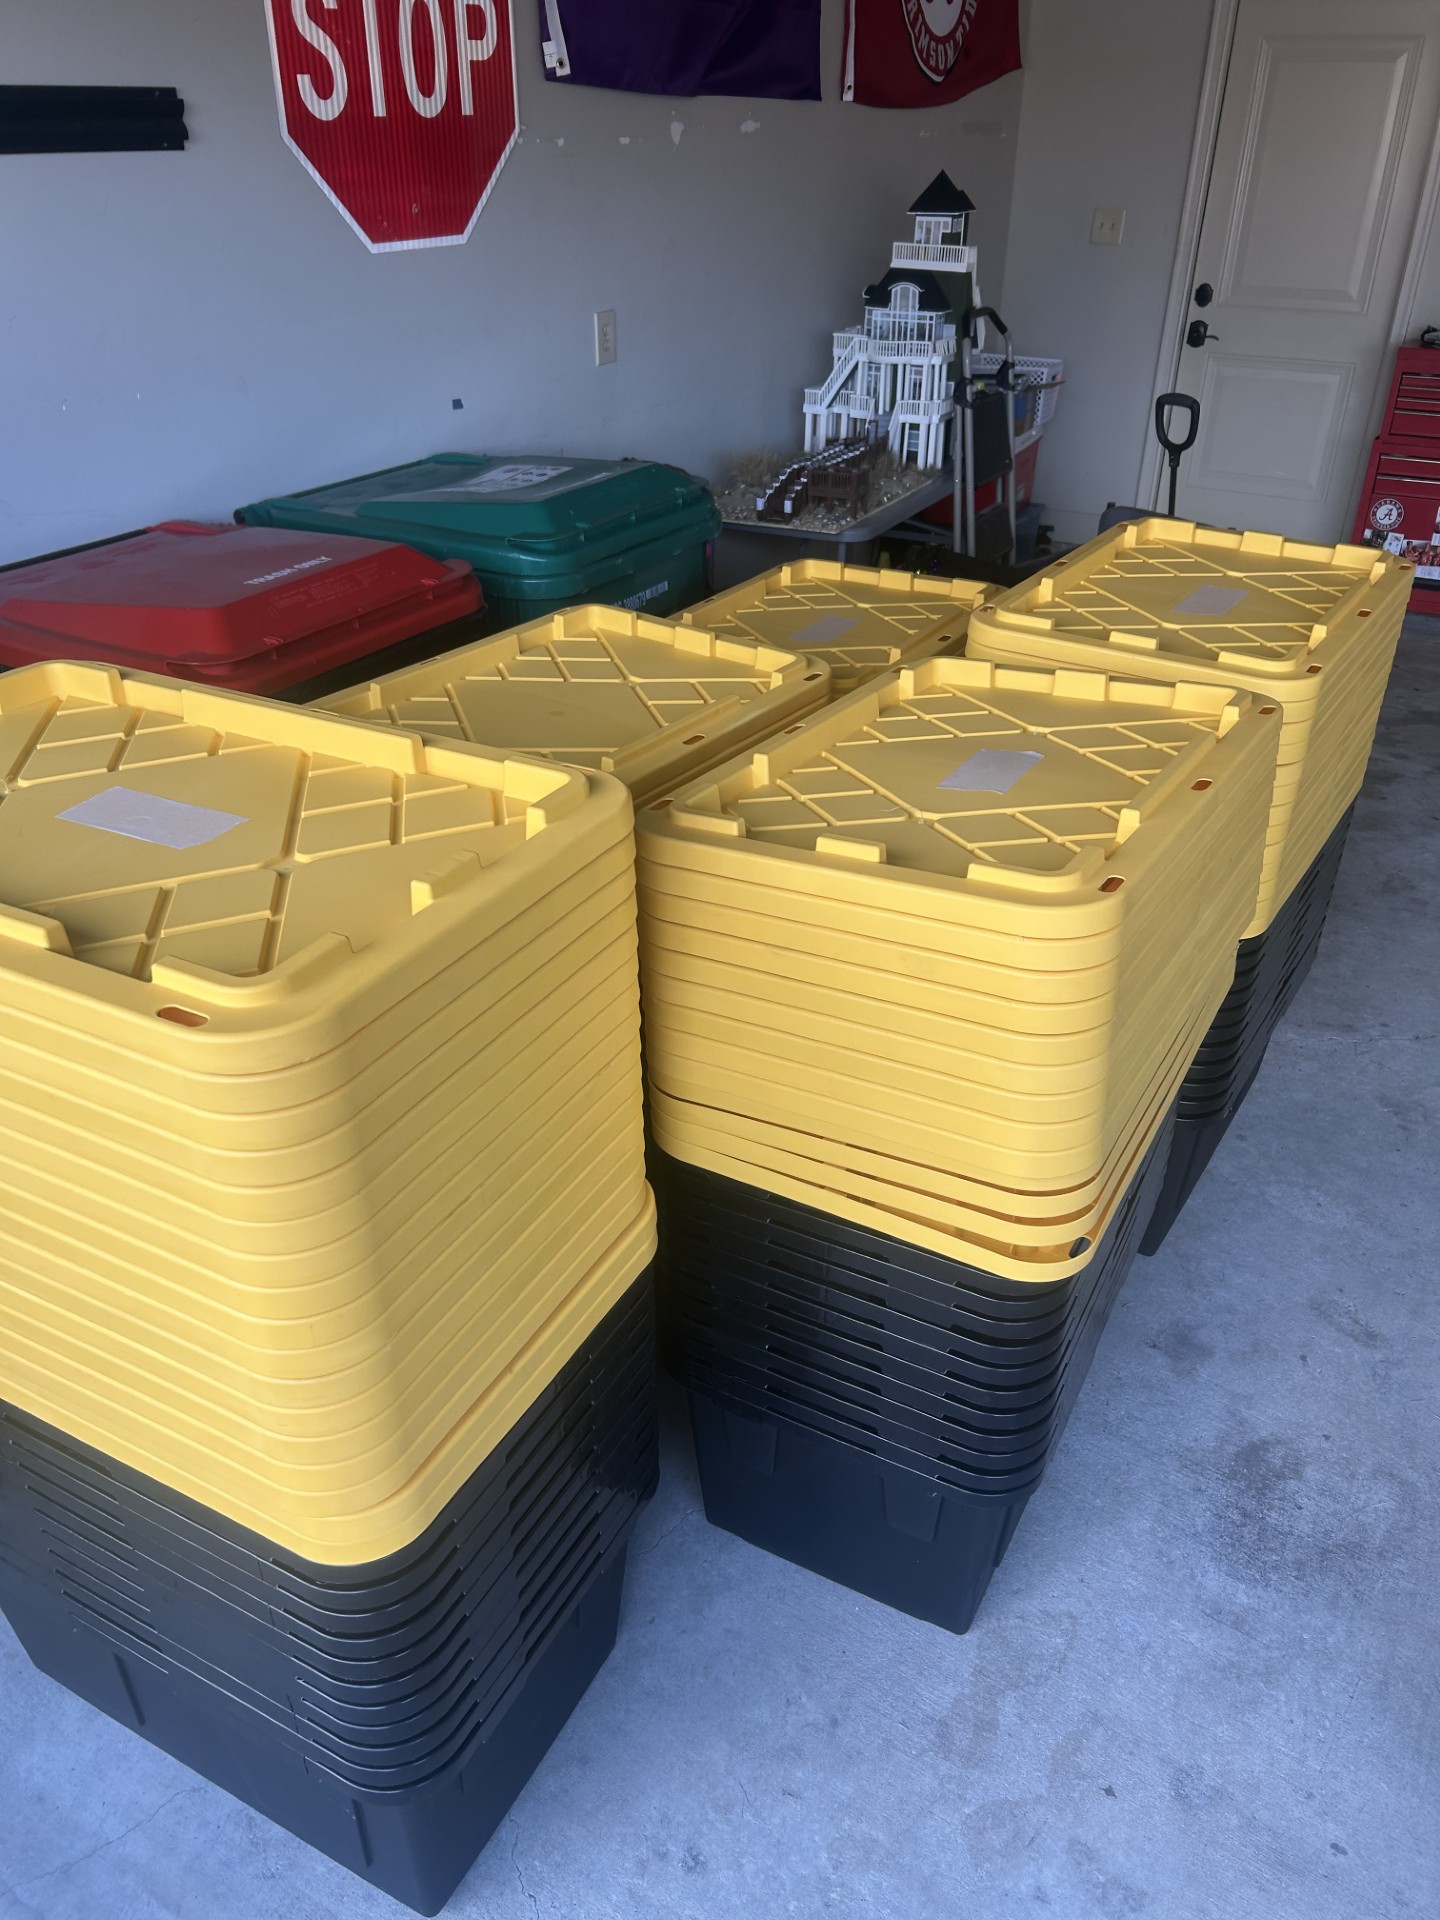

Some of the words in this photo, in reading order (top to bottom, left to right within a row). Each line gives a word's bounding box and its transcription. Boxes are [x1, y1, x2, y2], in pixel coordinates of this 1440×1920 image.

[291, 0, 497, 121] STOP
[907, 0, 955, 70] RIMSON
[956, 0, 977, 48] TID
[243, 568, 298, 585] TRASH
[293, 556, 333, 569] ONLY
